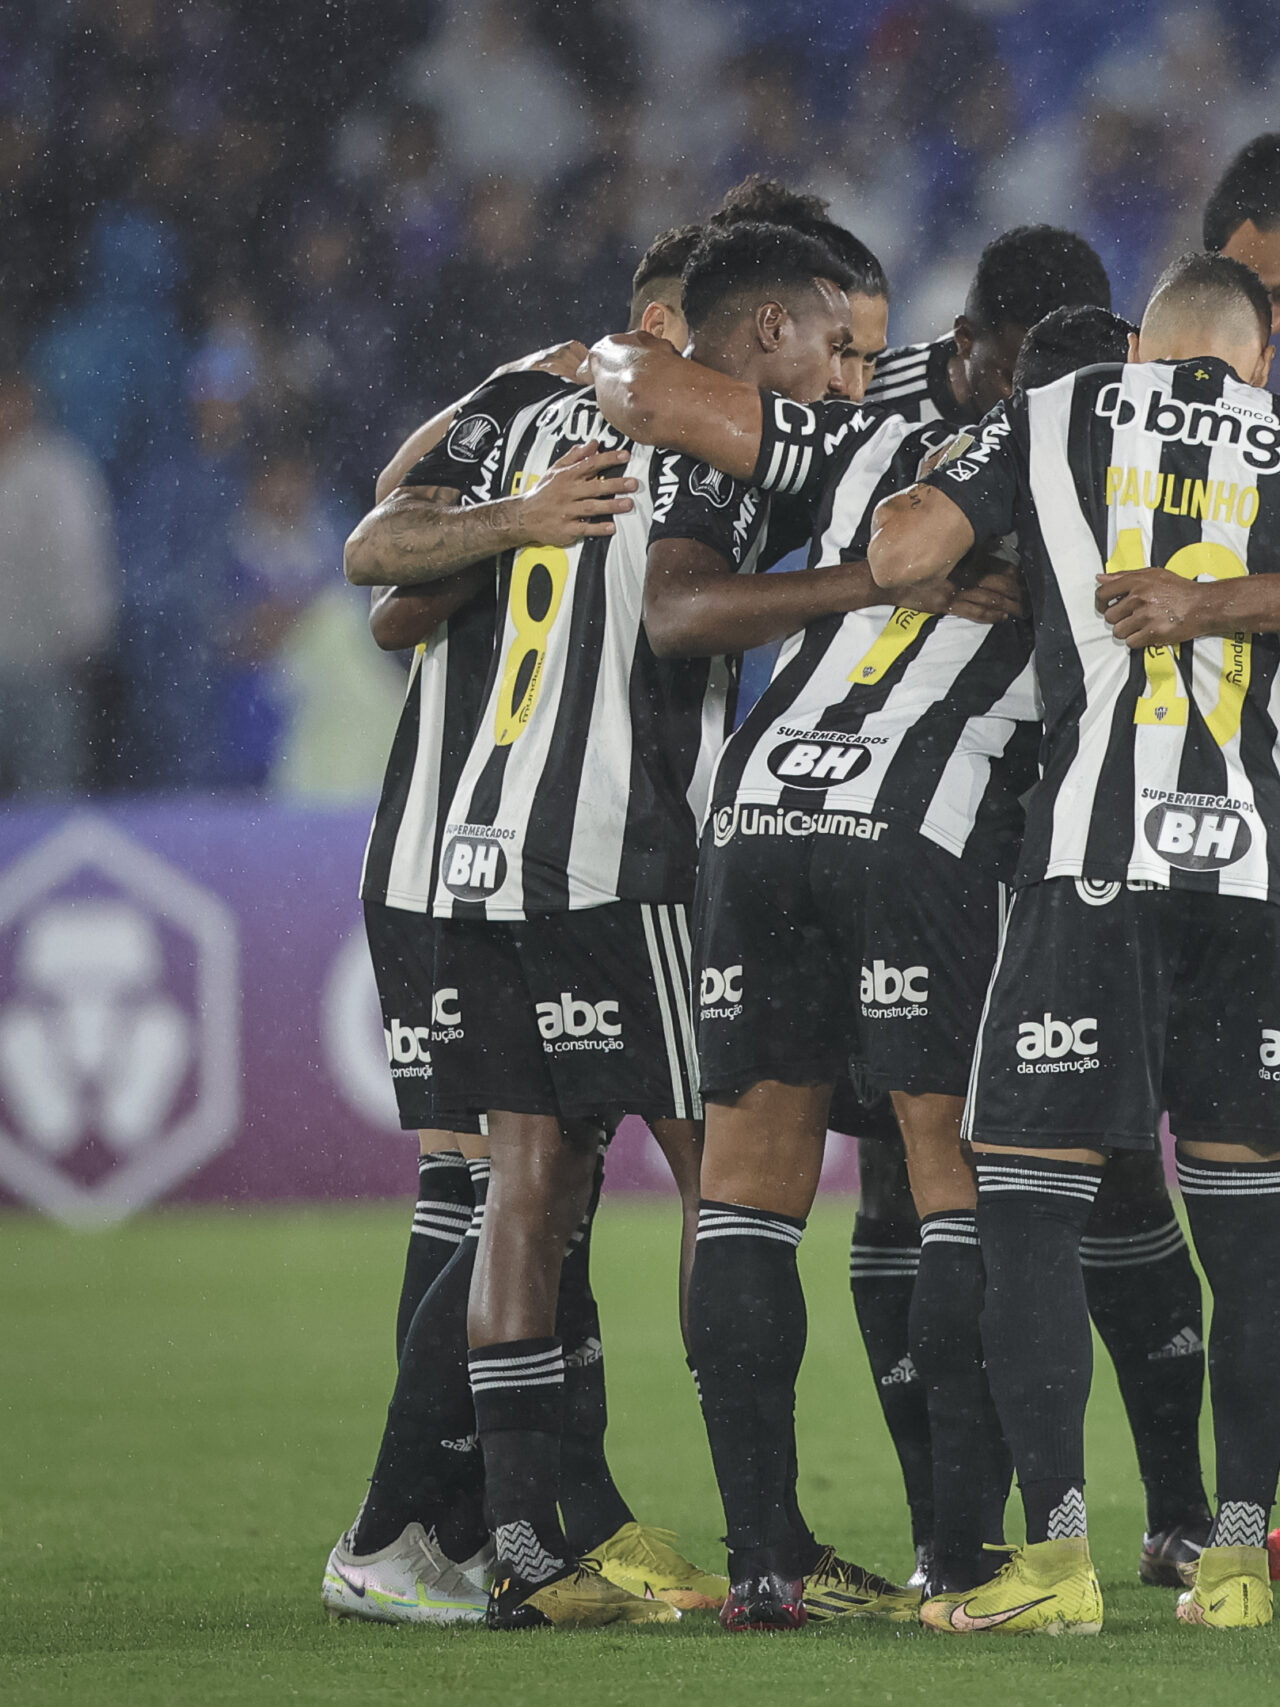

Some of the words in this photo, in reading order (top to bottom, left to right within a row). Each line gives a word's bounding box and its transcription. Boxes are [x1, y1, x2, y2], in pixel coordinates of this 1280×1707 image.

[1220, 401, 1274, 424] banco
[652, 454, 682, 524] MRV
[1105, 466, 1260, 528] PAULINHO
[494, 545, 569, 746] 8
[1225, 631, 1246, 686] mundia
[777, 726, 889, 745] SUPERMERCADOS
[777, 743, 864, 780] BH
[1141, 787, 1255, 813] SUPERMERCADOS
[741, 807, 889, 841] UniCesumar
[1157, 811, 1240, 860] BH
[447, 843, 499, 889] BH
[861, 960, 929, 1005] abc
[536, 992, 622, 1039] abc
[868, 1004, 928, 1020] construção
[554, 1038, 624, 1053] construção
[1016, 1012, 1098, 1060] abc
[1017, 1061, 1034, 1074] da
[1035, 1057, 1100, 1074] construção
